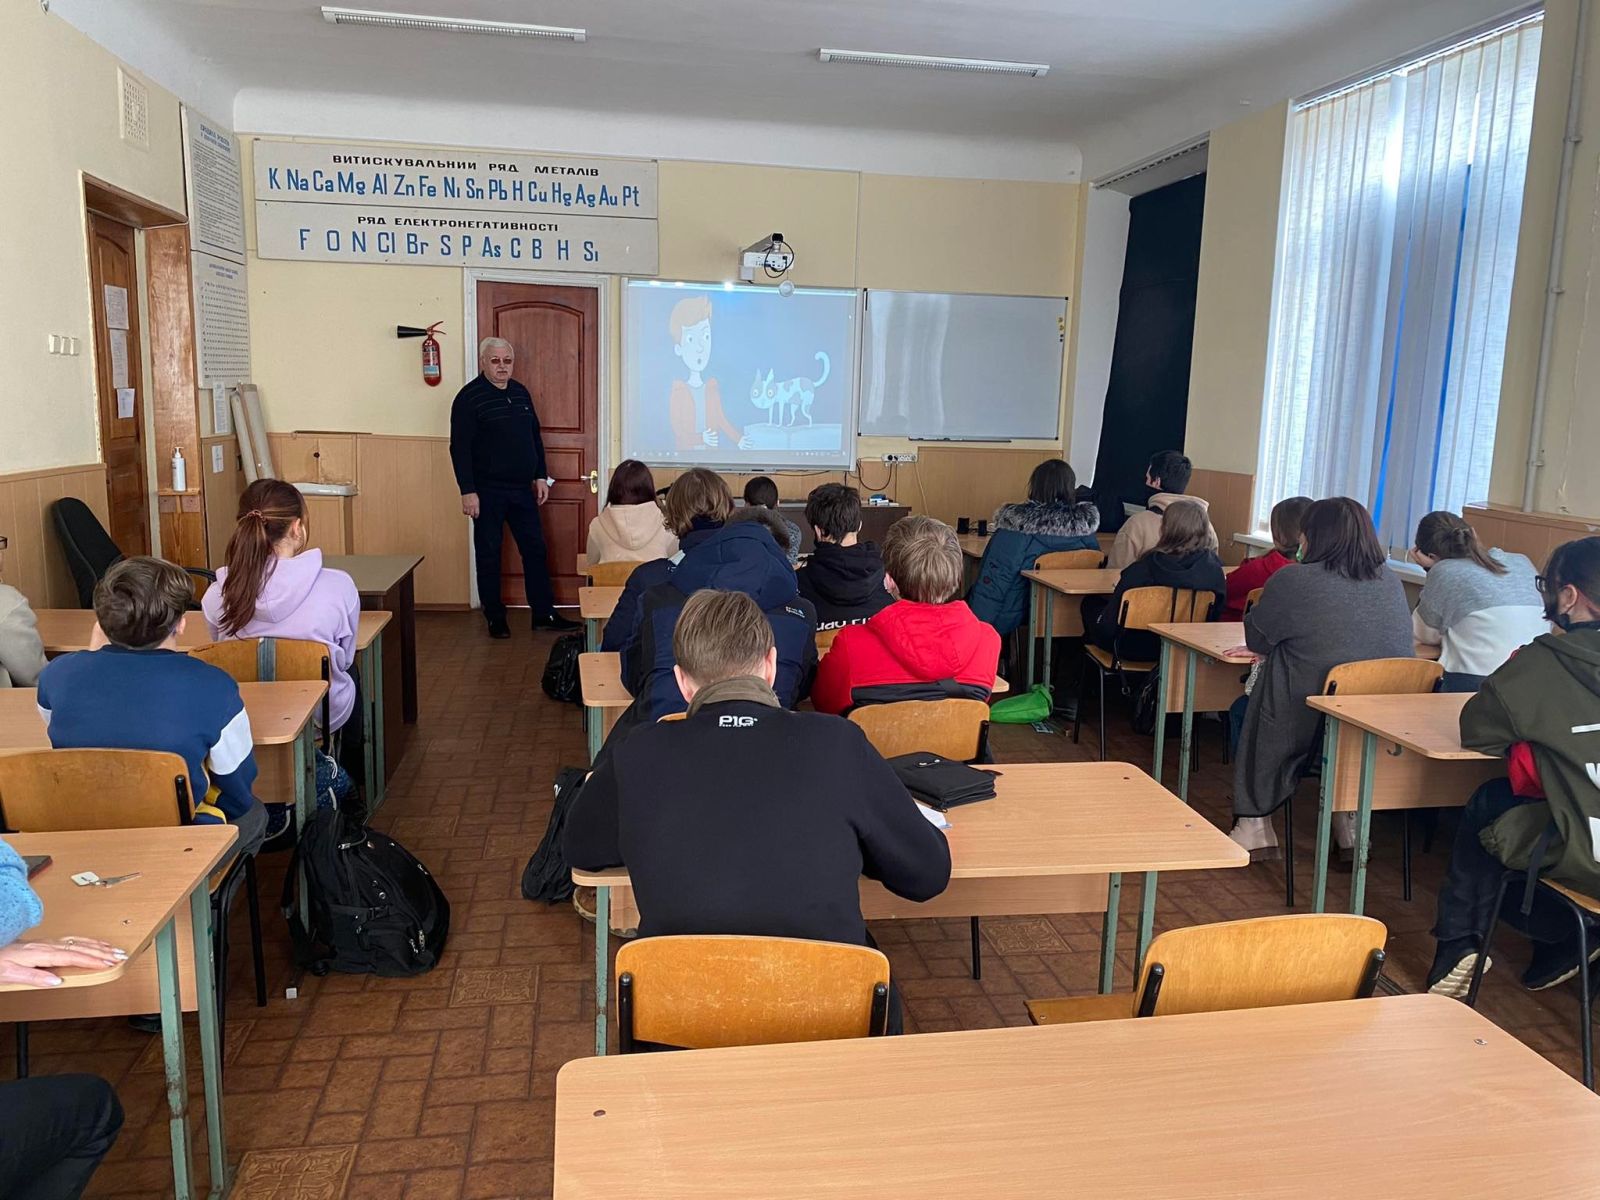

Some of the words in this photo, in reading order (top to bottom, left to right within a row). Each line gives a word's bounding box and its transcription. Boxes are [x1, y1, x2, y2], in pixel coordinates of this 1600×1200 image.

[488, 163, 519, 173] РЯД
[534, 165, 599, 177] МЕТАЛІВ
[269, 168, 281, 190] K
[287, 169, 309, 191] Na
[313, 170, 334, 192] Ca
[338, 171, 366, 195] Mg
[372, 173, 387, 195] Al
[394, 174, 415, 196] Zn
[419, 176, 437, 198] Fe
[466, 178, 484, 199] Sn
[488, 179, 508, 200] Pb
[513, 180, 523, 201] H
[528, 181, 547, 202] Cu
[552, 182, 572, 207] Hg
[575, 183, 596, 208] Ag
[599, 185, 618, 206] Au
[622, 186, 640, 207] Pt
[357, 216, 387, 225] РЯД
[394, 217, 559, 232] ЕЛЕКТРОНЕГАТИВНОСТІ
[300, 229, 310, 250] F
[326, 230, 340, 251] O
[352, 231, 366, 253] N
[406, 233, 429, 255] Br
[440, 234, 451, 256] S
[462, 235, 472, 256] P
[482, 236, 501, 258] As
[510, 237, 521, 259] C
[532, 238, 542, 259] B
[558, 239, 569, 261] H
